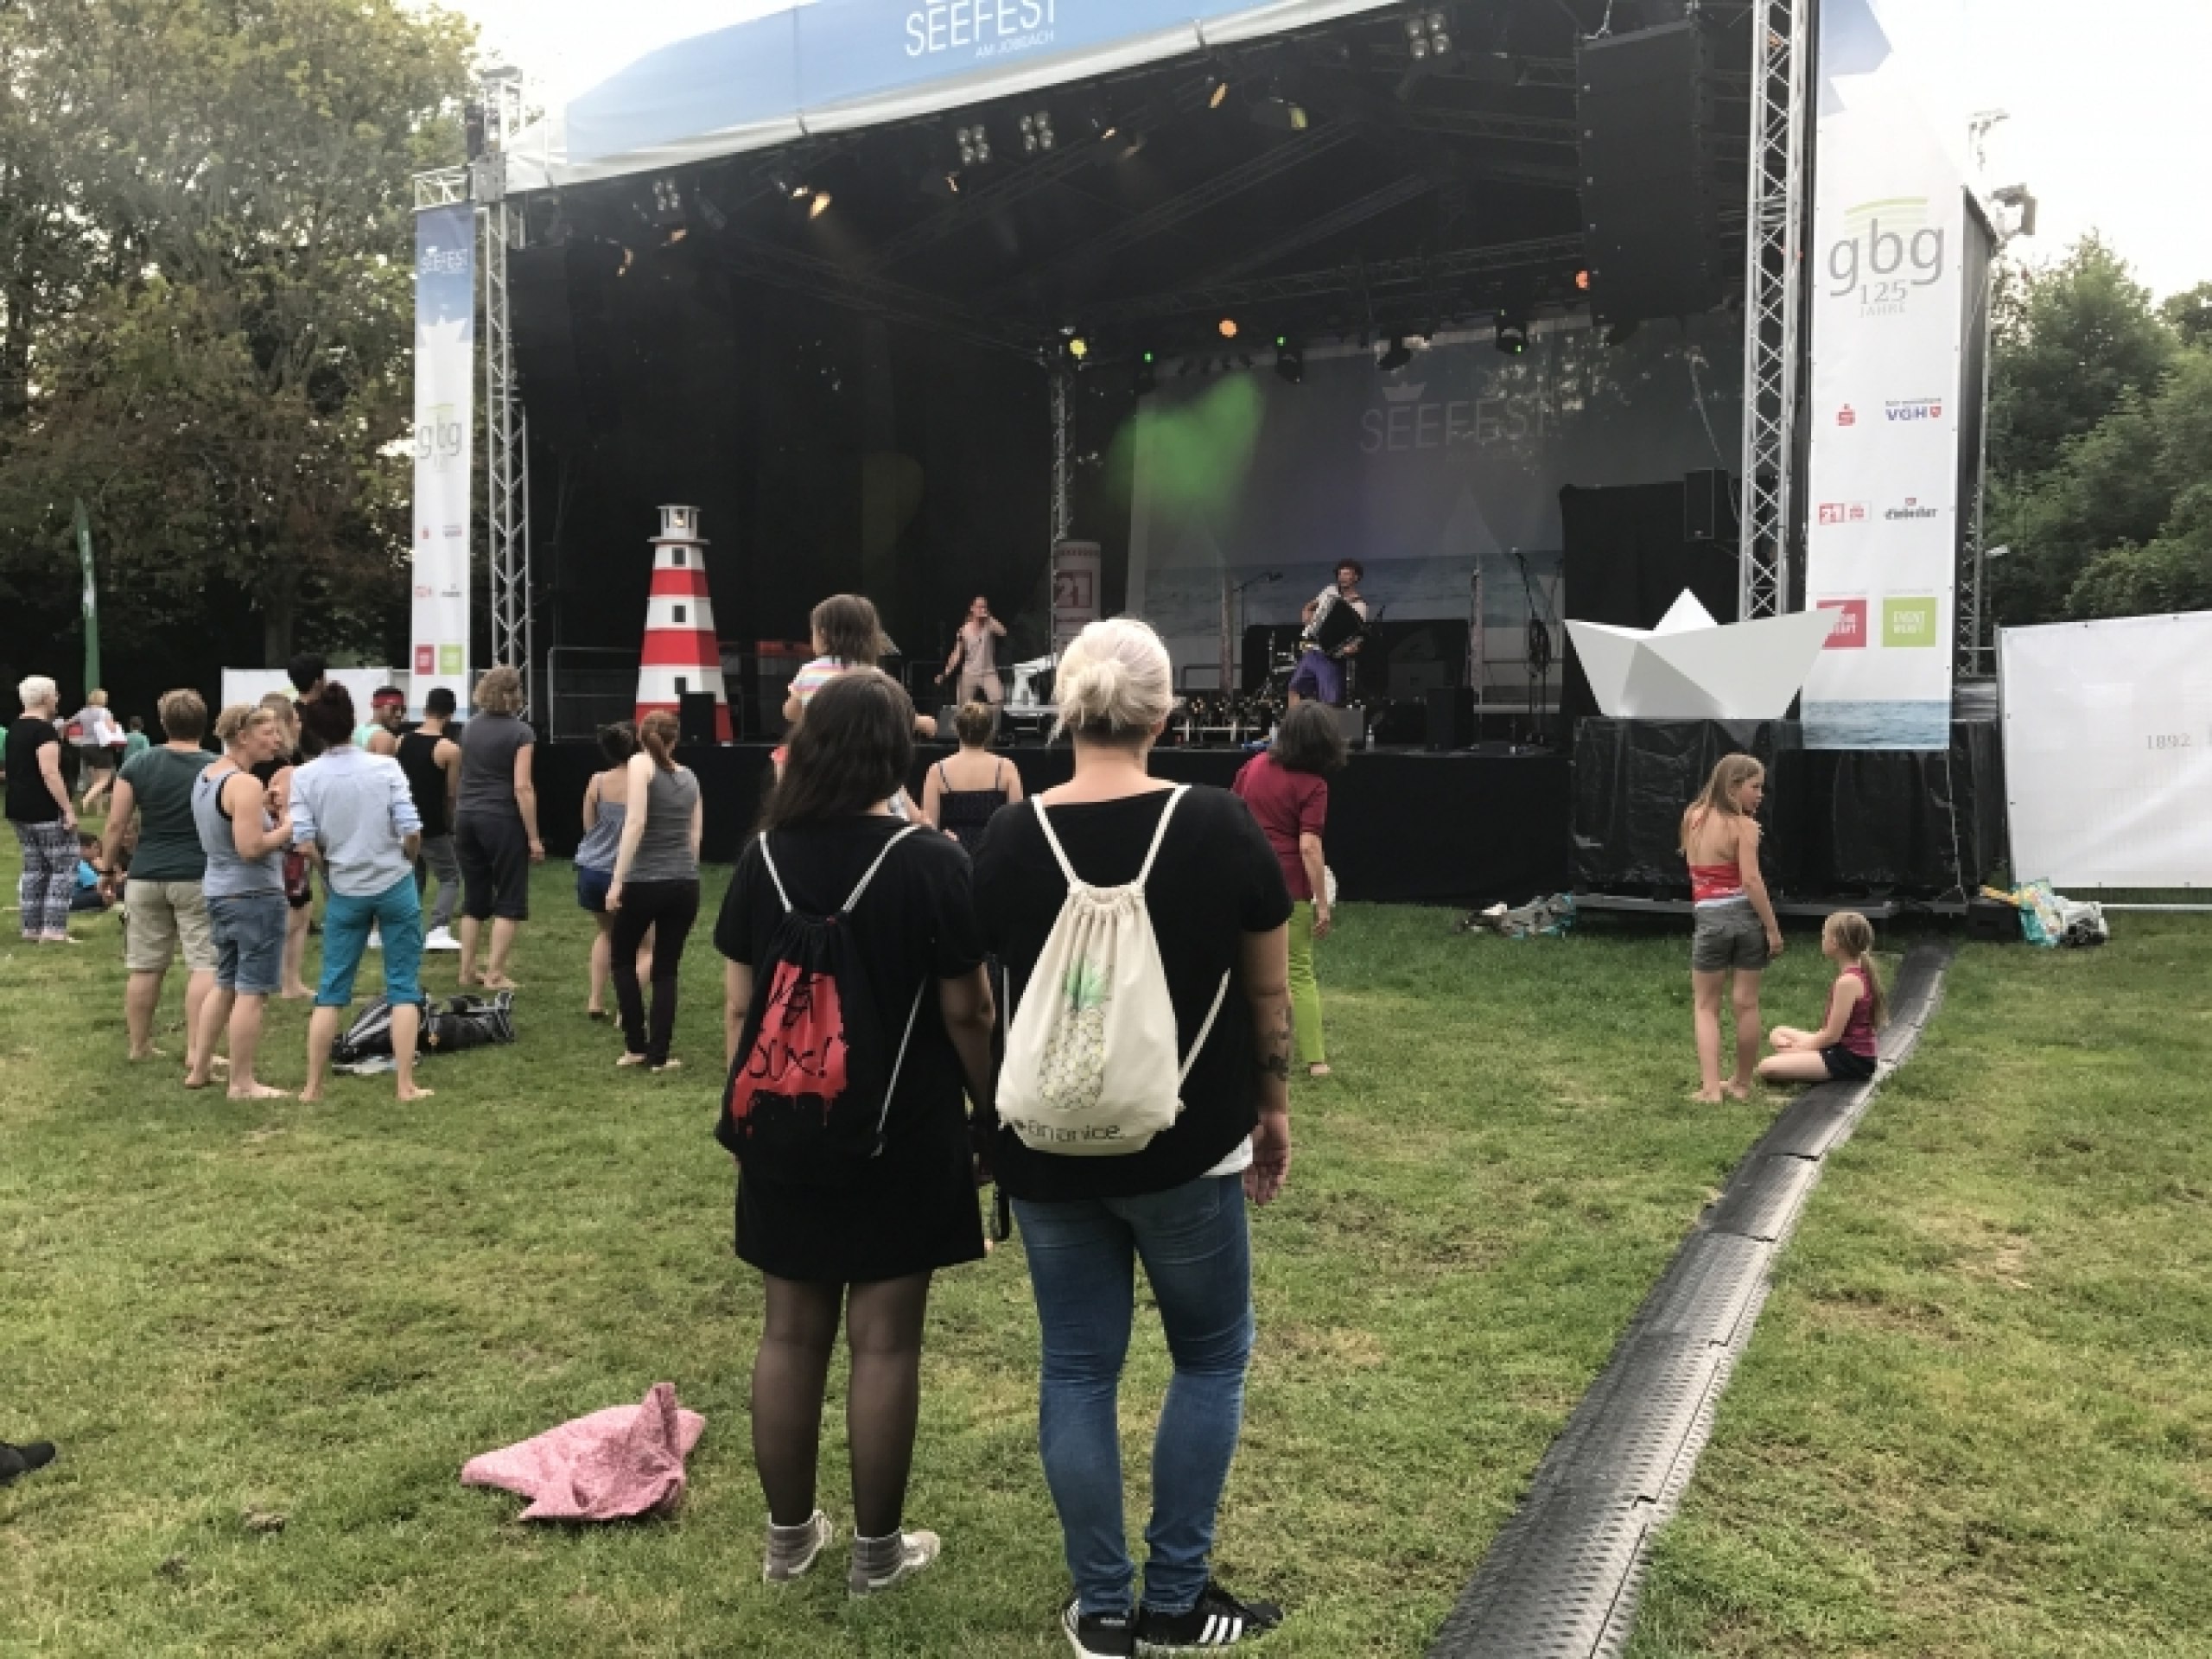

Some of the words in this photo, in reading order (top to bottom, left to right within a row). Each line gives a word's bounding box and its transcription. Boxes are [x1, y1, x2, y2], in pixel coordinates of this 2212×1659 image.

[905, 0, 1054, 57] SEEFEST
[1828, 218, 1944, 296] gbg
[1860, 279, 1908, 305] 125
